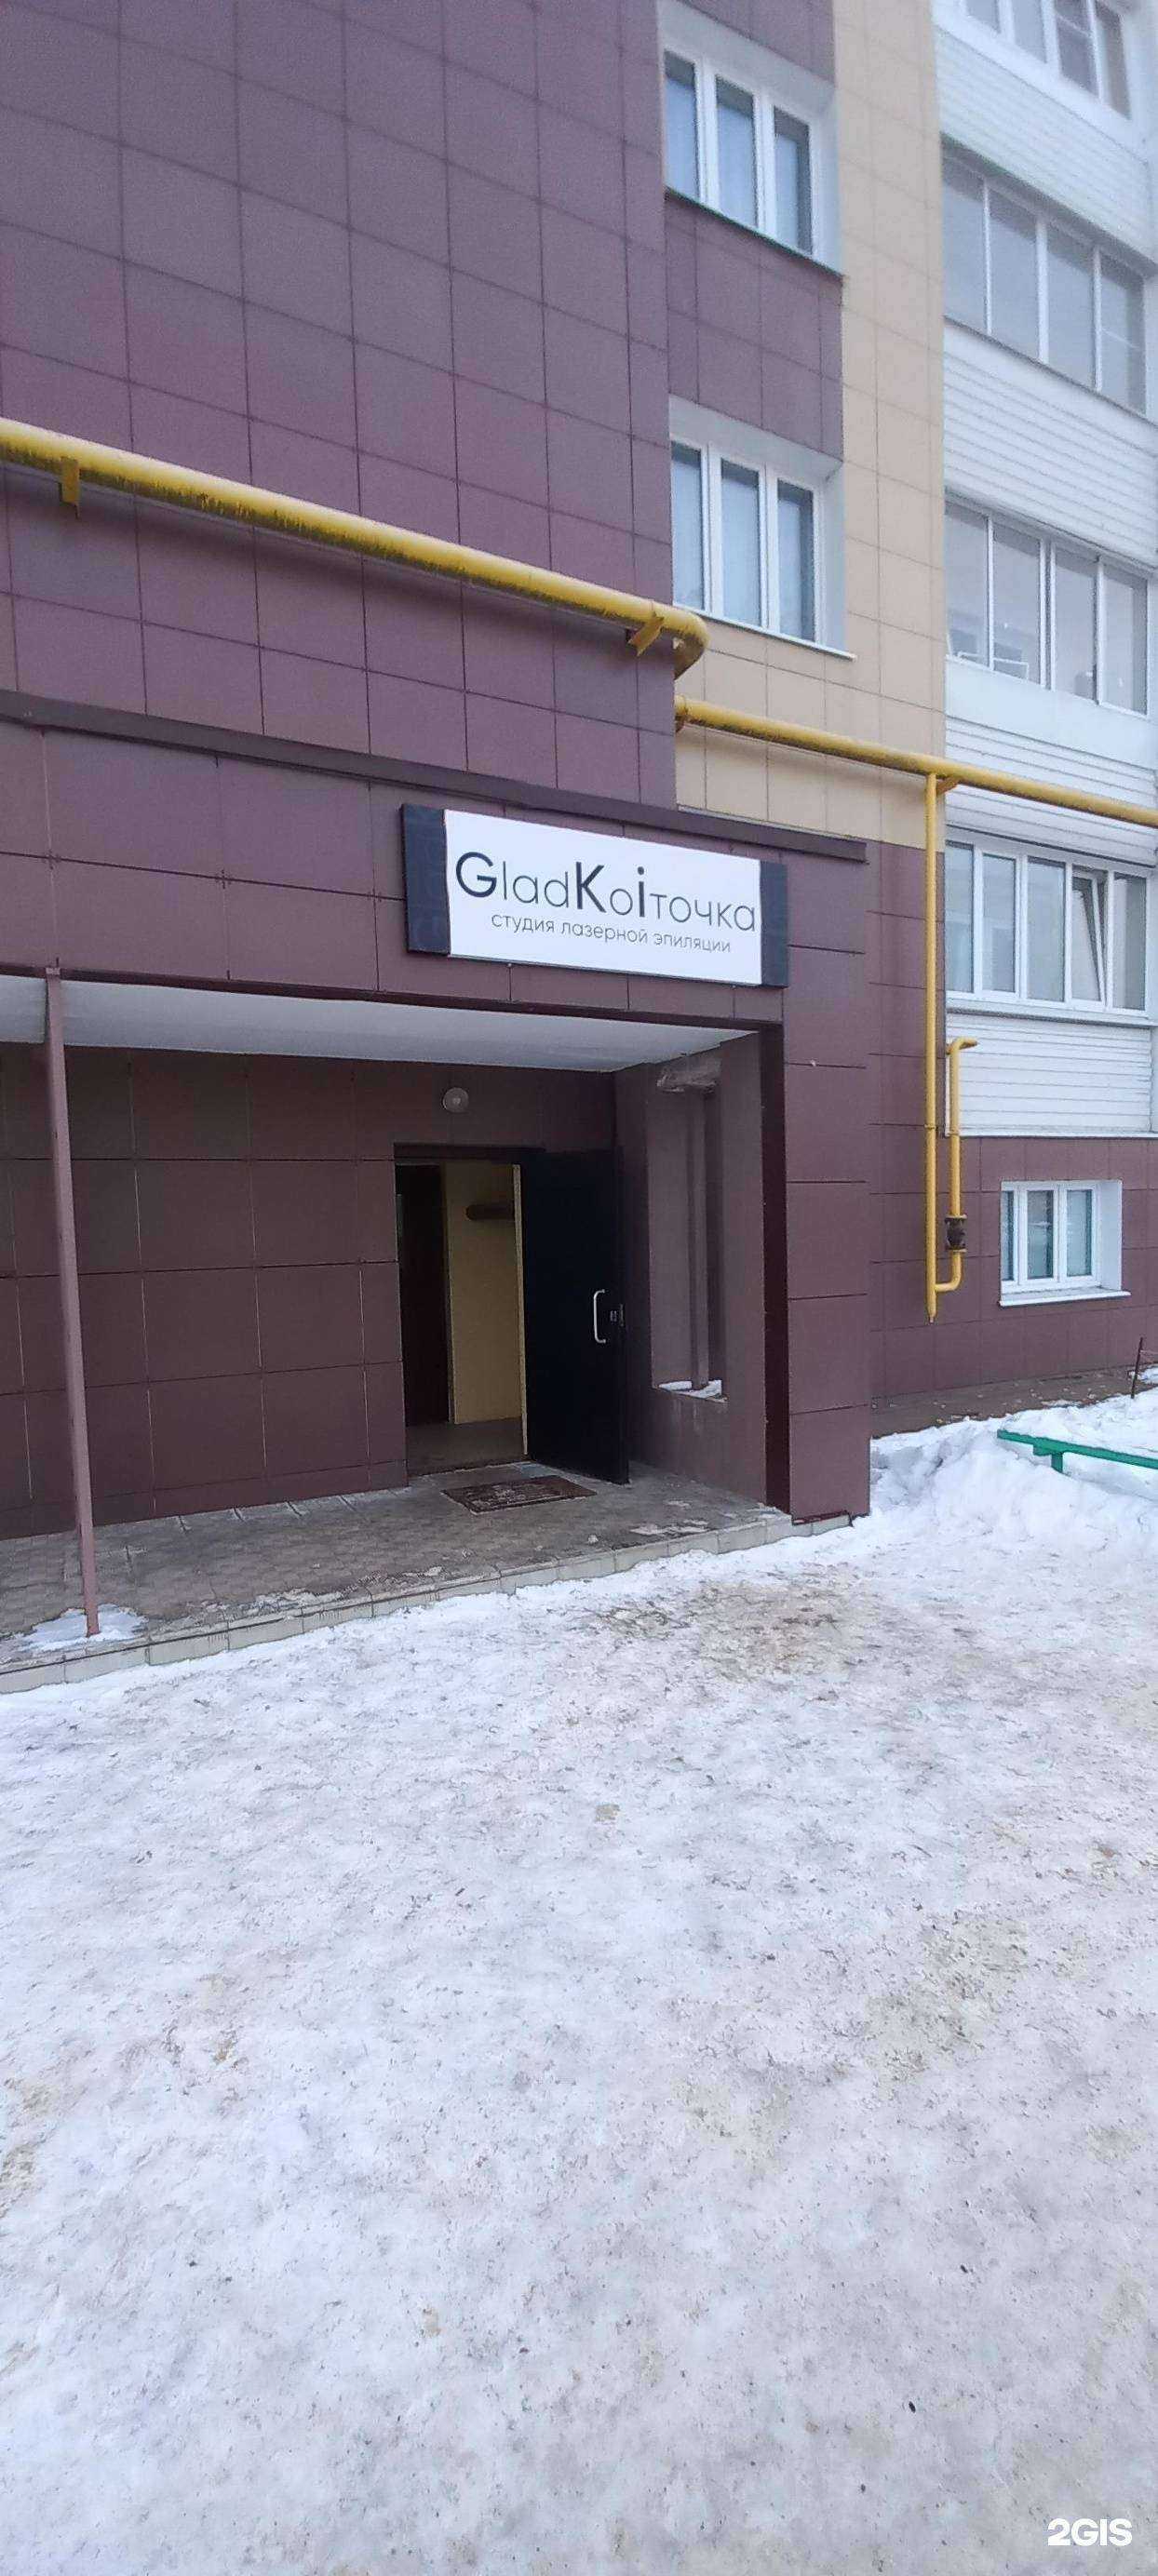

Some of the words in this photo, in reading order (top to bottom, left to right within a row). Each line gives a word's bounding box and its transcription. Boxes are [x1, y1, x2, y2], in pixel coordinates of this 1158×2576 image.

[491, 914, 556, 933] студия
[560, 921, 649, 944] лазерной
[653, 932, 732, 953] эпиляции
